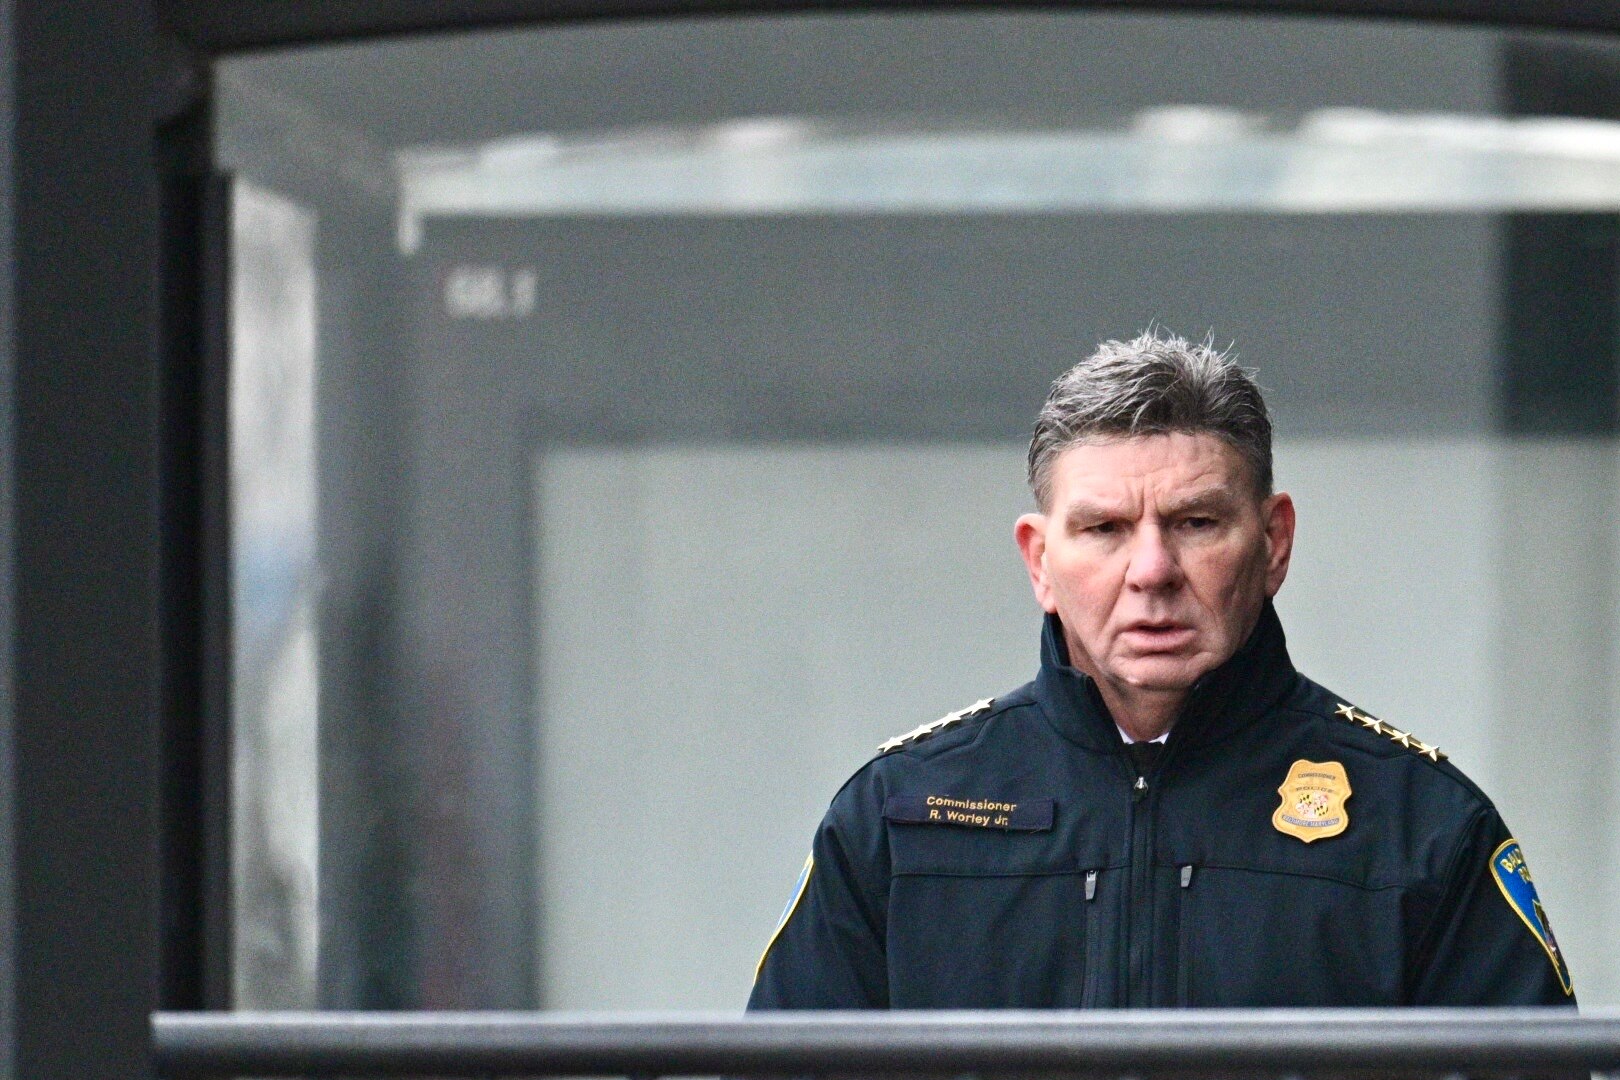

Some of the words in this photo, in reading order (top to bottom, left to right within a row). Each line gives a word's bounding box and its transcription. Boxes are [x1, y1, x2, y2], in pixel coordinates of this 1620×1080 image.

[926, 796, 1017, 812] Commissioner
[929, 809, 942, 820] R.
[947, 811, 990, 826] Worley
[994, 815, 1009, 826] Jr.
